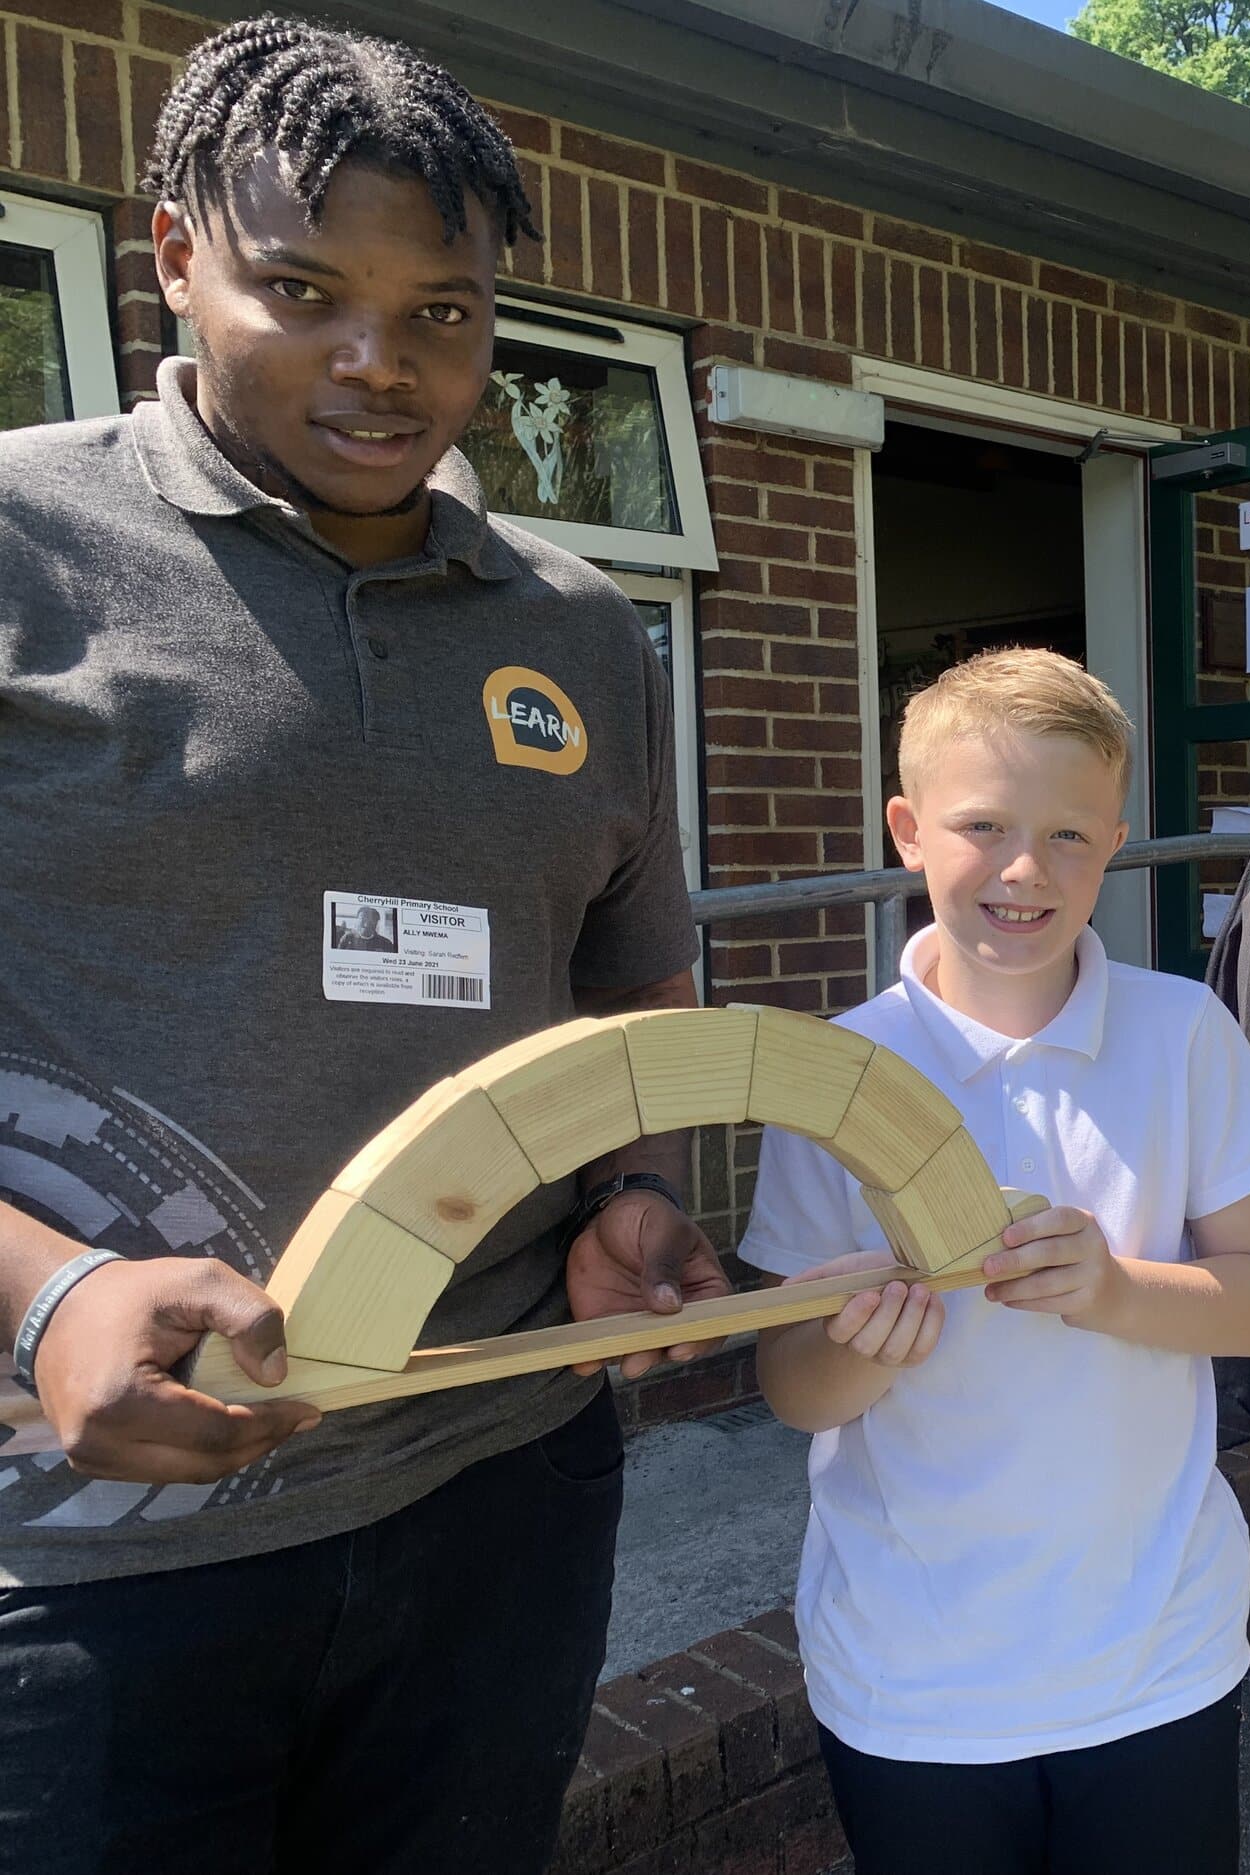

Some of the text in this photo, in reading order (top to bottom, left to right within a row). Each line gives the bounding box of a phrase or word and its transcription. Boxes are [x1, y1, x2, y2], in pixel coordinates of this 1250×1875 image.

[491, 696, 580, 748] LEARN
[357, 895, 459, 913] CherryHill Primary School
[420, 913, 466, 927] VISITOR
[382, 957, 397, 965] Wed
[20, 1327, 37, 1352] Not
[29, 1269, 77, 1329] Ashamed
